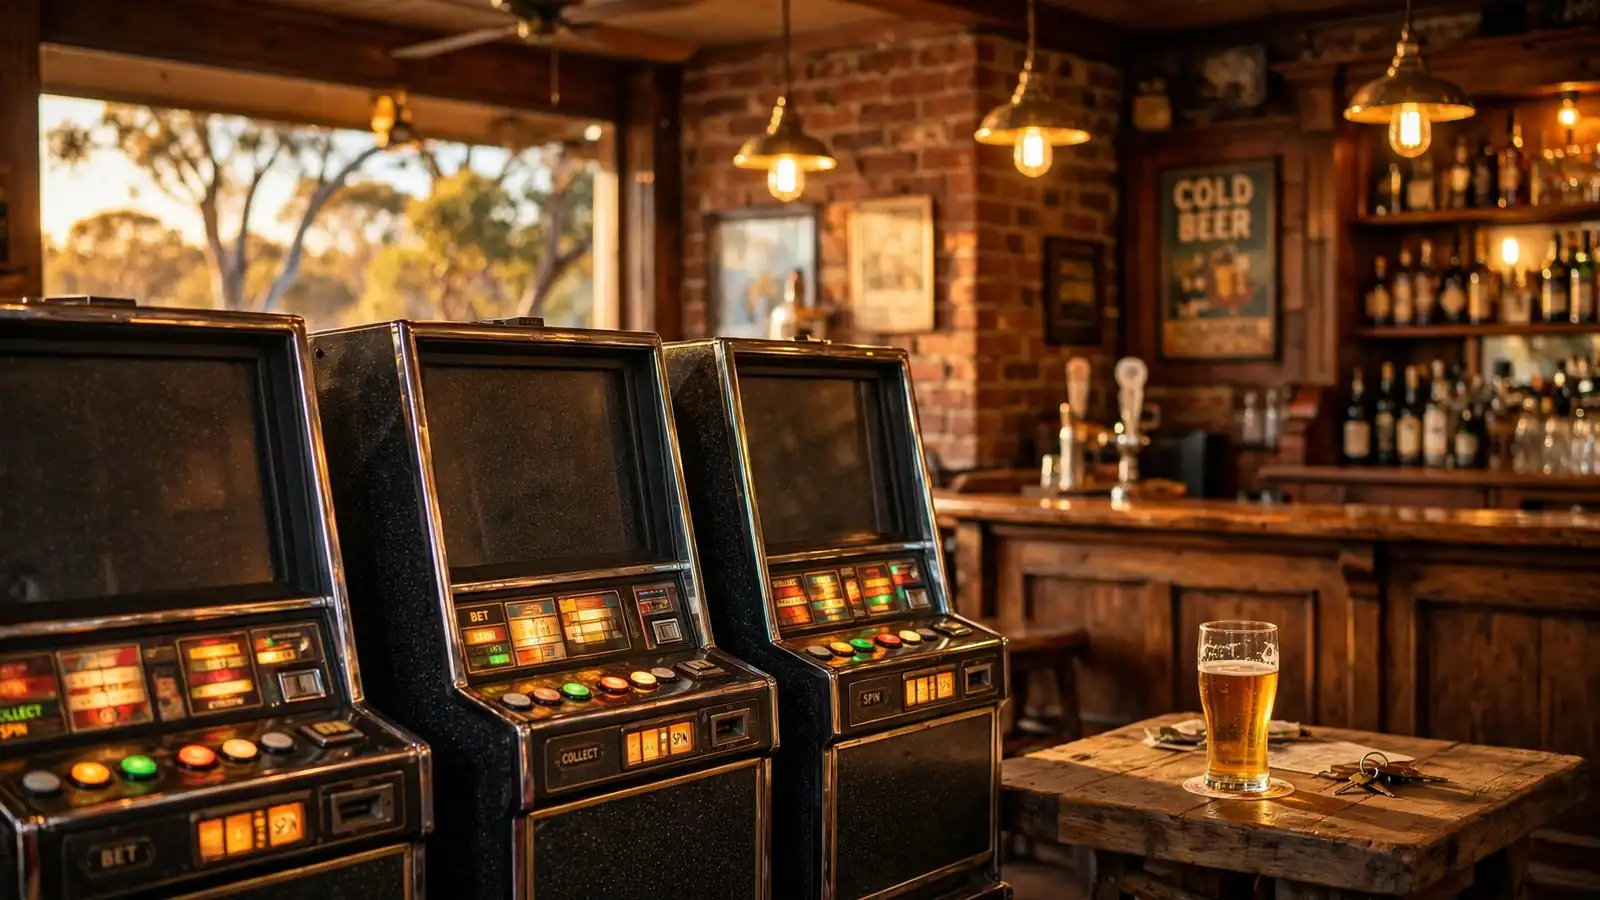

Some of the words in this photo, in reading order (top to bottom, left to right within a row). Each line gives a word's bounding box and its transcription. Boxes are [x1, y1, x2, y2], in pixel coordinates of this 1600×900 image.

[1173, 173, 1254, 208] COLD
[1178, 208, 1252, 243] BEER
[470, 610, 488, 622] BET
[863, 691, 880, 705] SPIN
[562, 747, 598, 764] COLLECT
[102, 844, 137, 868] BET
